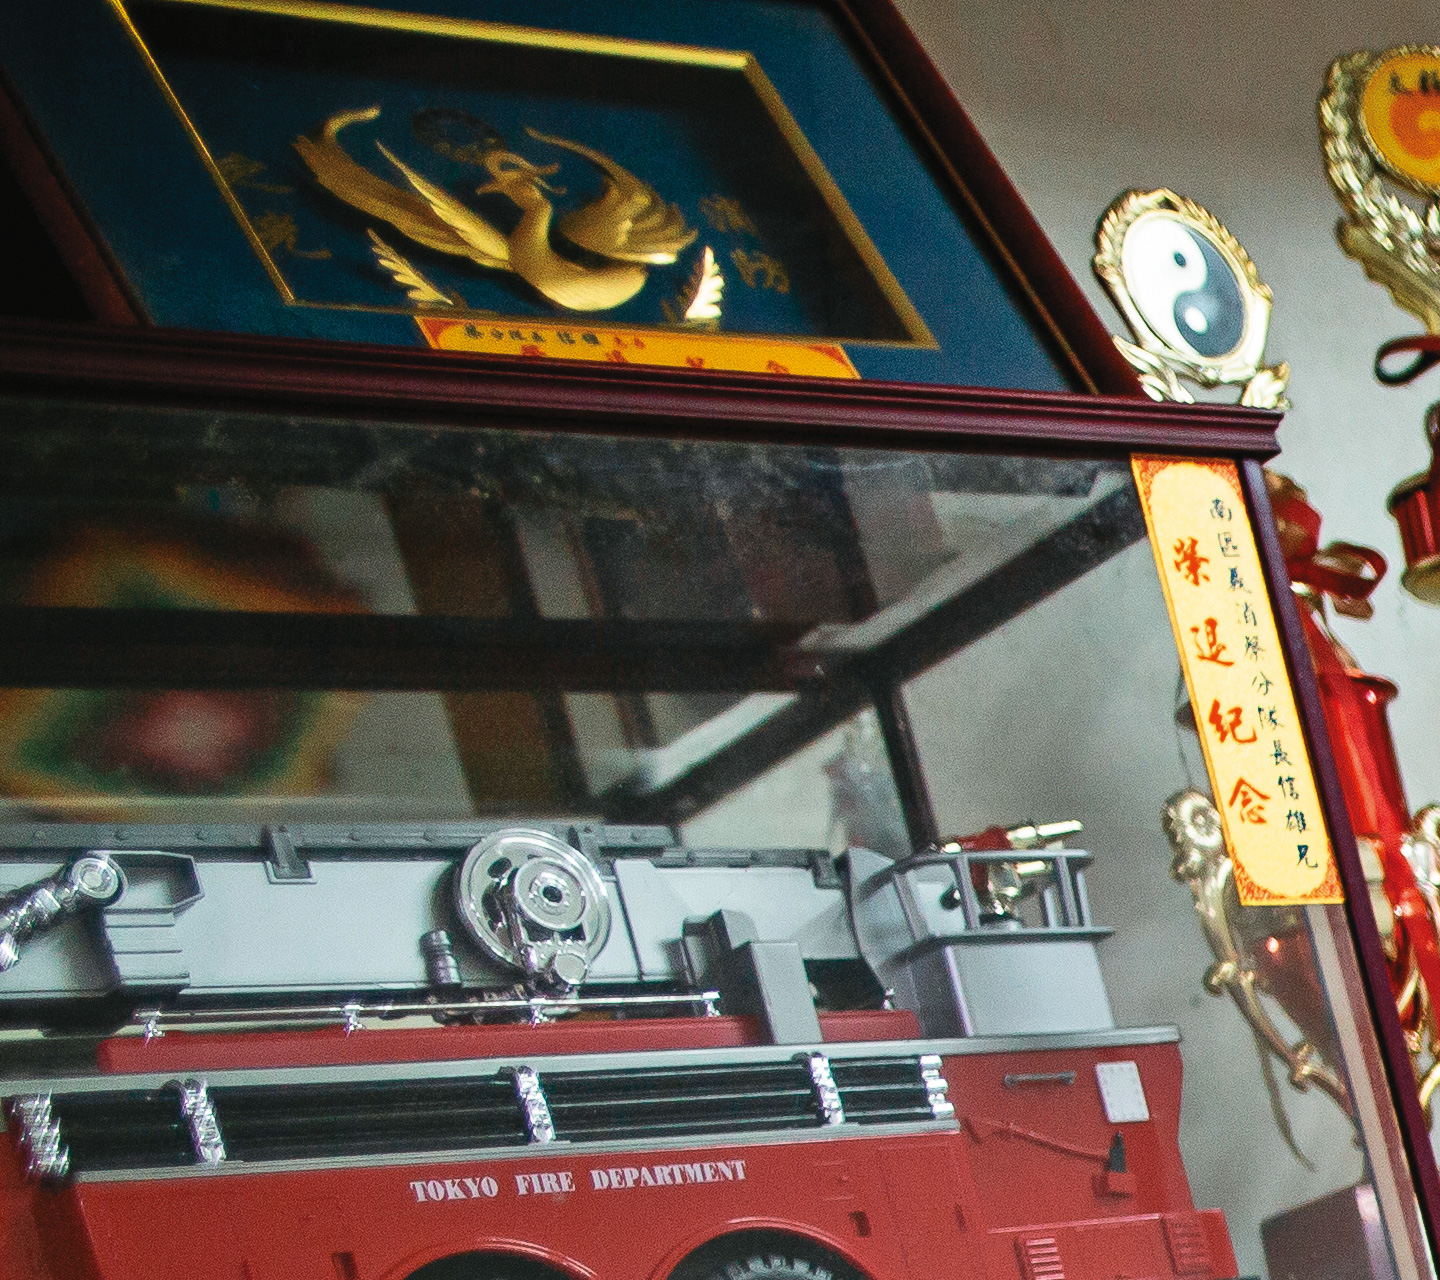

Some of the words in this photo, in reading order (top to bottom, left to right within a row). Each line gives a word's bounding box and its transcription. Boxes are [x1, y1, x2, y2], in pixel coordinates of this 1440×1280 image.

[1173, 537, 1271, 824] 榮退紀念
[410, 1176, 499, 1202] TOKYO
[514, 1171, 575, 1196] FIRE
[590, 1159, 746, 1191] DEPARTMENT
